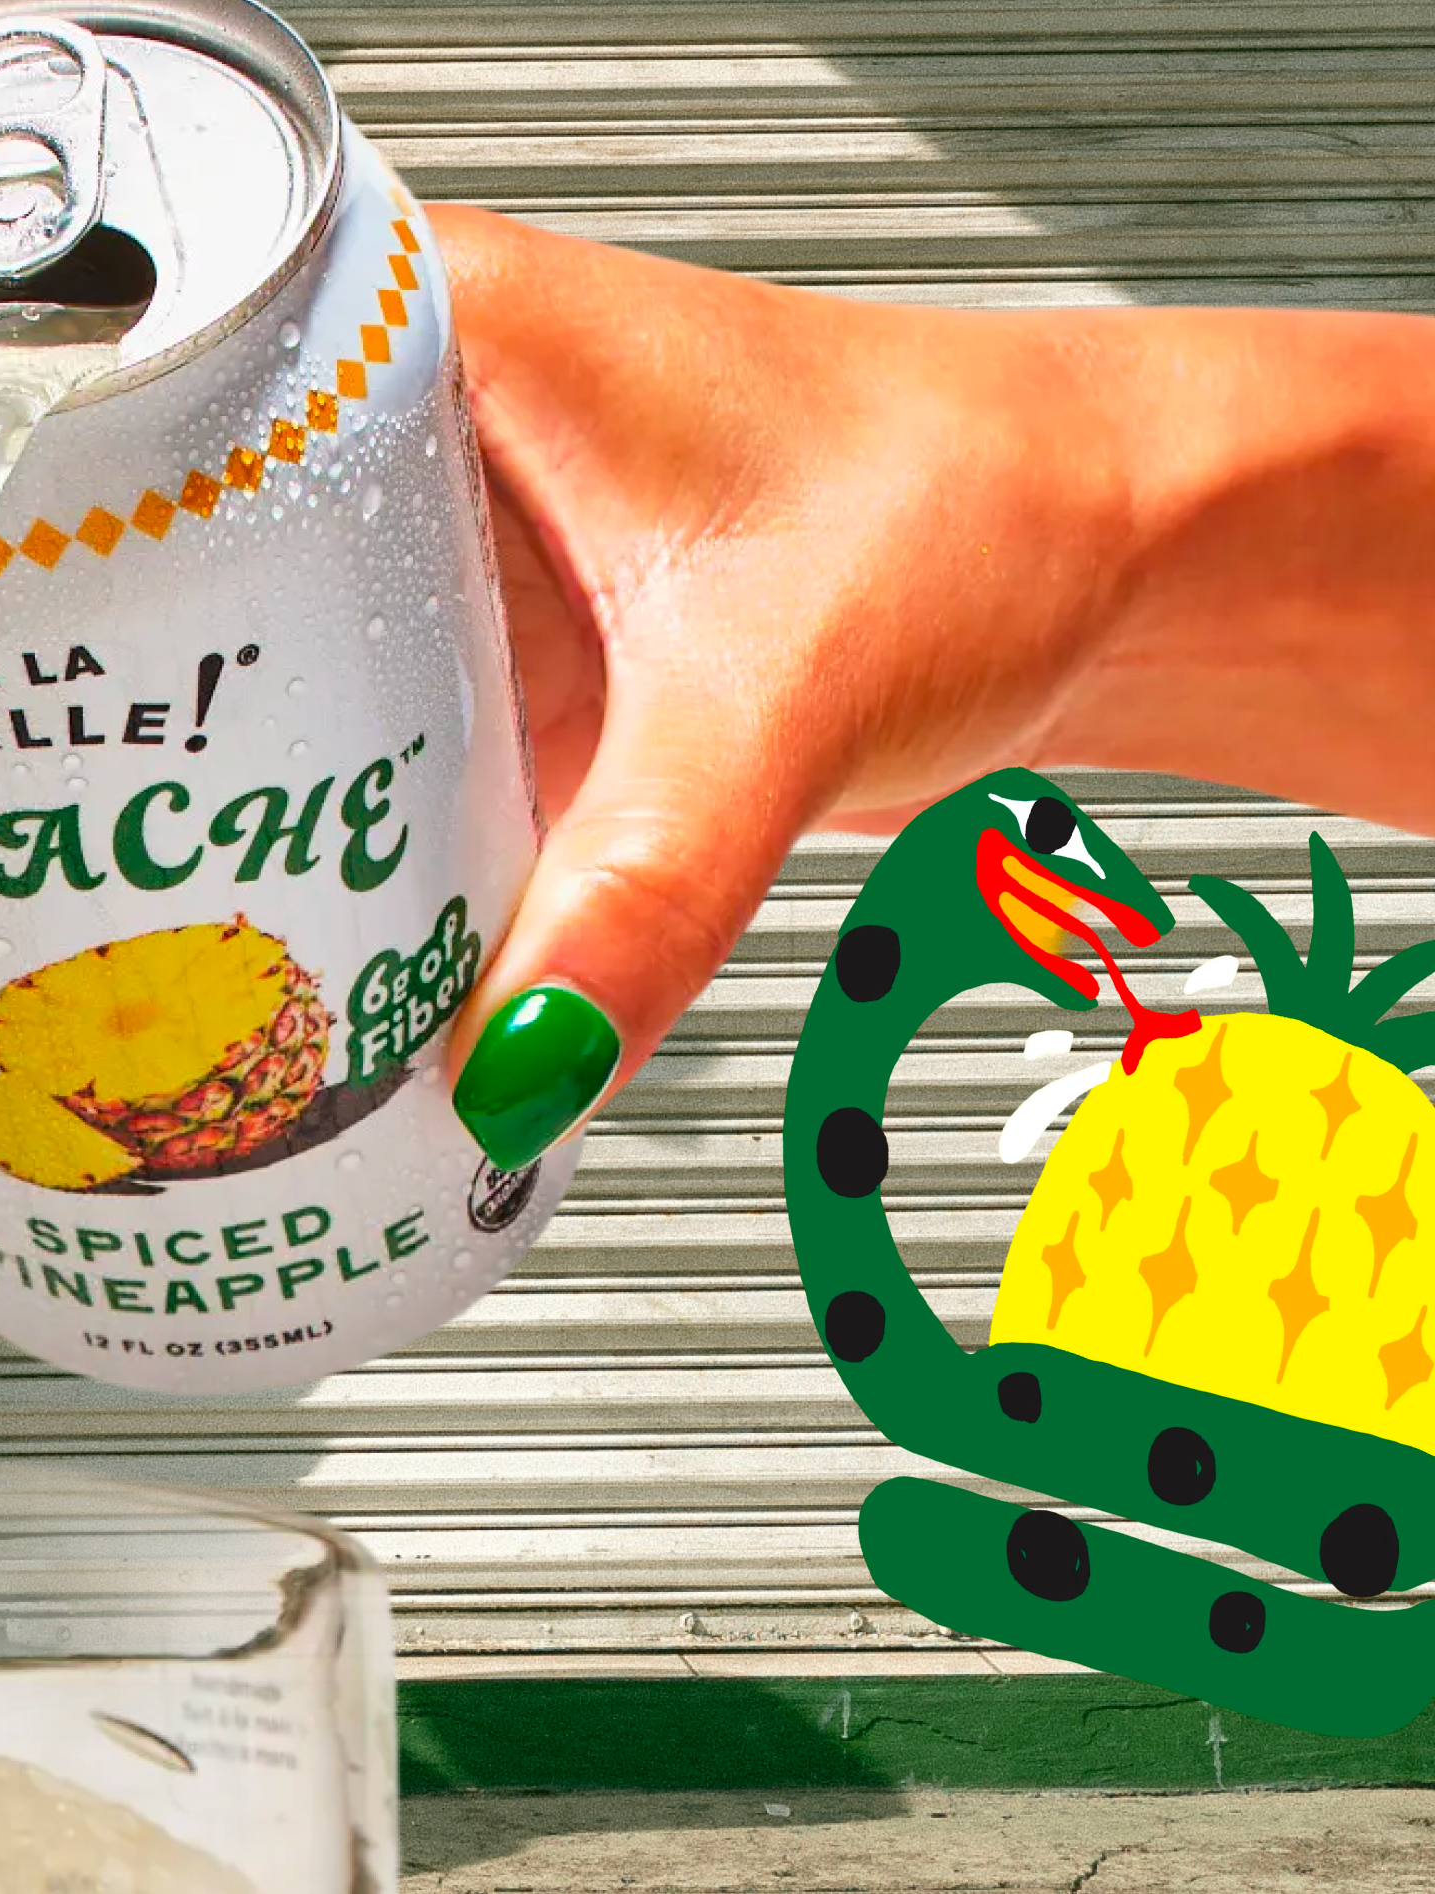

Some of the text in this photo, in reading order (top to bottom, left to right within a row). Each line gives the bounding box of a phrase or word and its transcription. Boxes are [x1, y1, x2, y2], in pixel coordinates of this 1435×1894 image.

[21, 645, 106, 686] LA
[362, 912, 459, 1014] 6g of
[361, 948, 473, 1077] Fiber
[26, 1205, 332, 1266] SPICED
[82, 1319, 333, 1357] 12 FL OZ (355ML)
